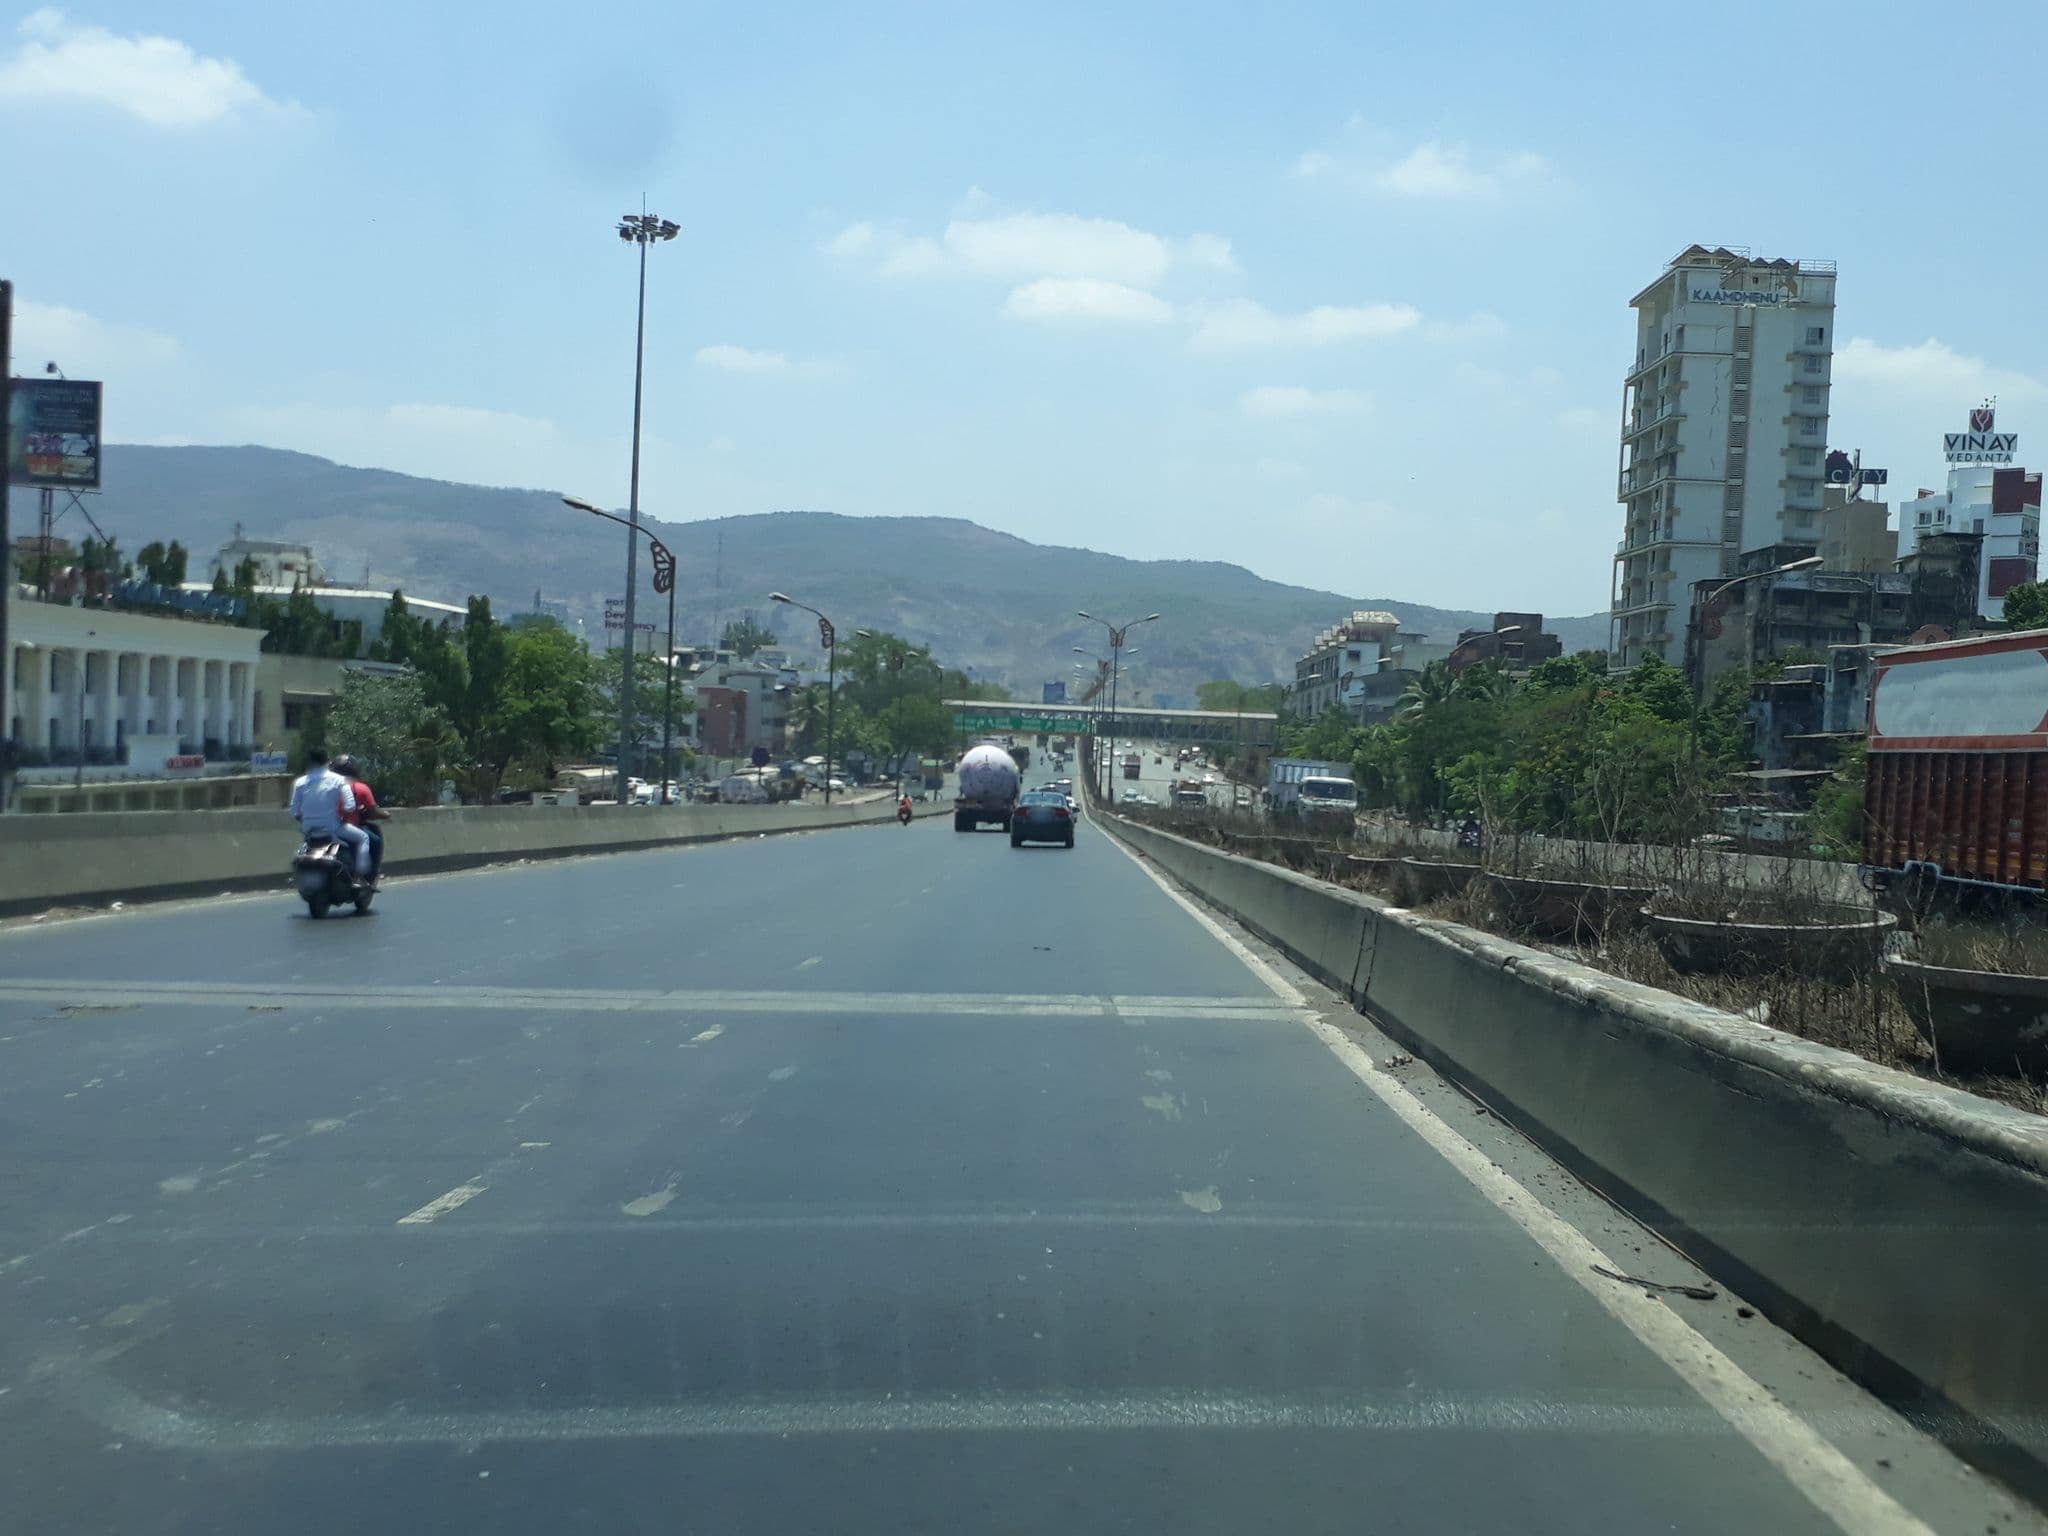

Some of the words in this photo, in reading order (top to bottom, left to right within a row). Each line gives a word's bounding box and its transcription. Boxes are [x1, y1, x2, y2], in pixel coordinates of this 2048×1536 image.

[1693, 289, 1779, 304] KAAMDHENU
[1946, 434, 2018, 451] VINAY
[1948, 452, 2013, 463] VEDANTA
